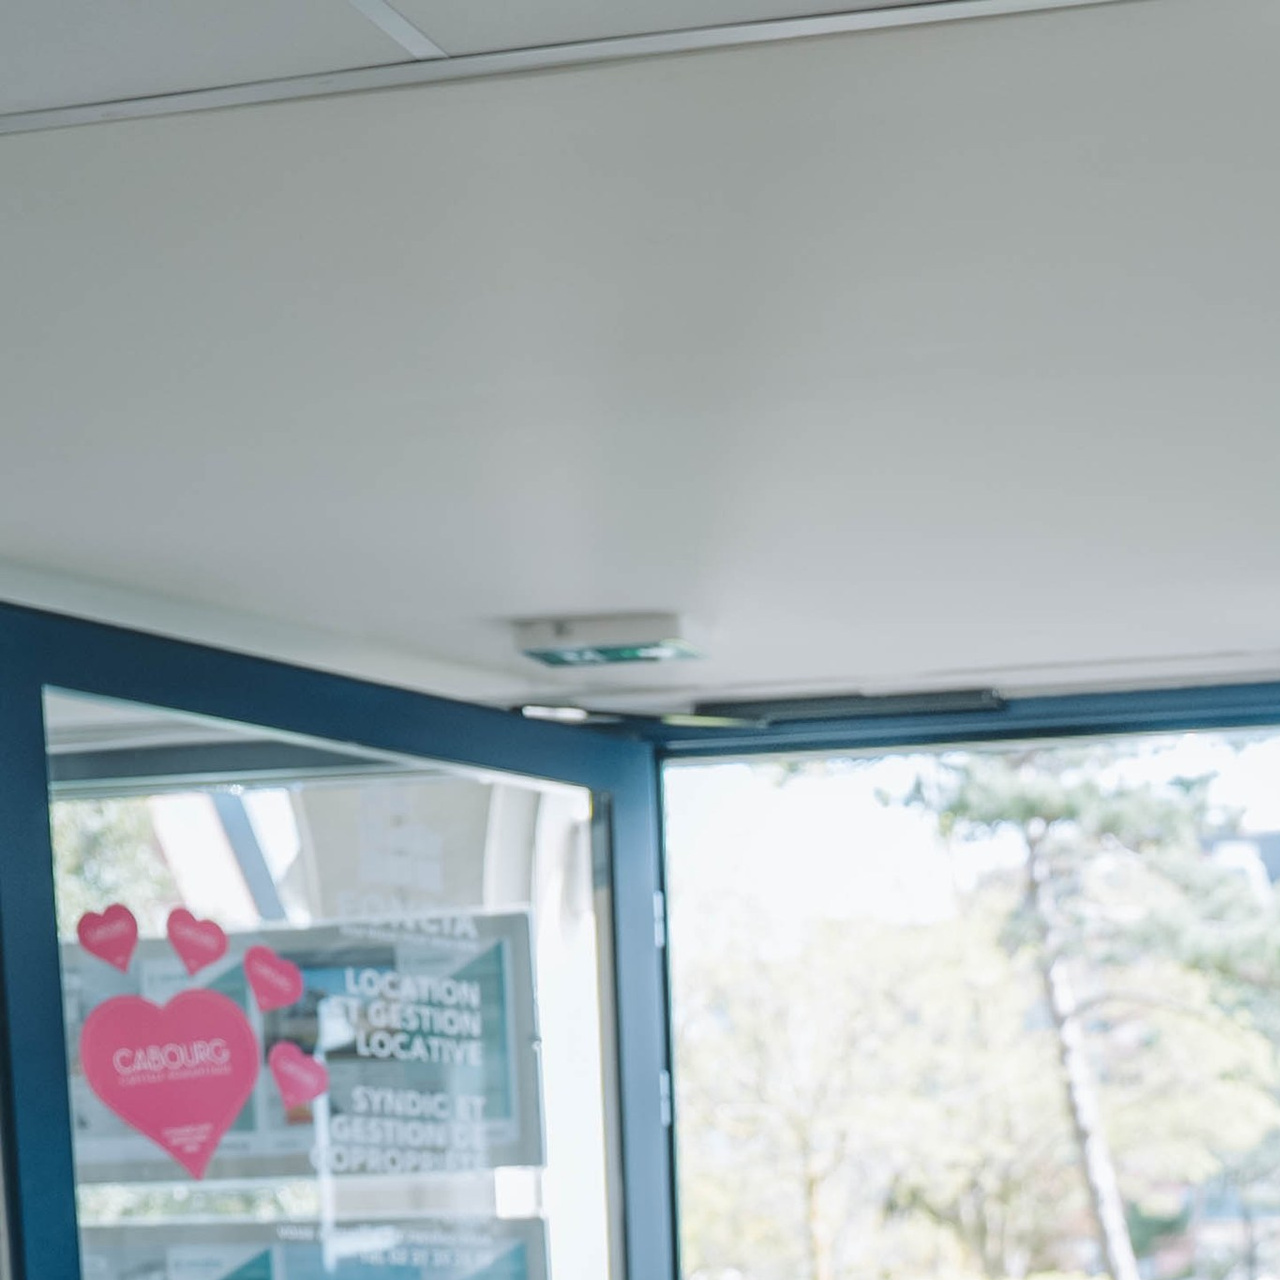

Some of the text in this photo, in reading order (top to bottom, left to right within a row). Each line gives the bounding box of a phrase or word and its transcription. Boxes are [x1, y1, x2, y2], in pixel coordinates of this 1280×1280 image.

[345, 966, 481, 1010] LOCATION
[367, 1001, 482, 1038] GESTION
[112, 1037, 231, 1075] CABOURG
[355, 1029, 483, 1067] LOCATIVE
[351, 1085, 450, 1119] SYNDIC
[330, 1113, 447, 1147] GESTION
